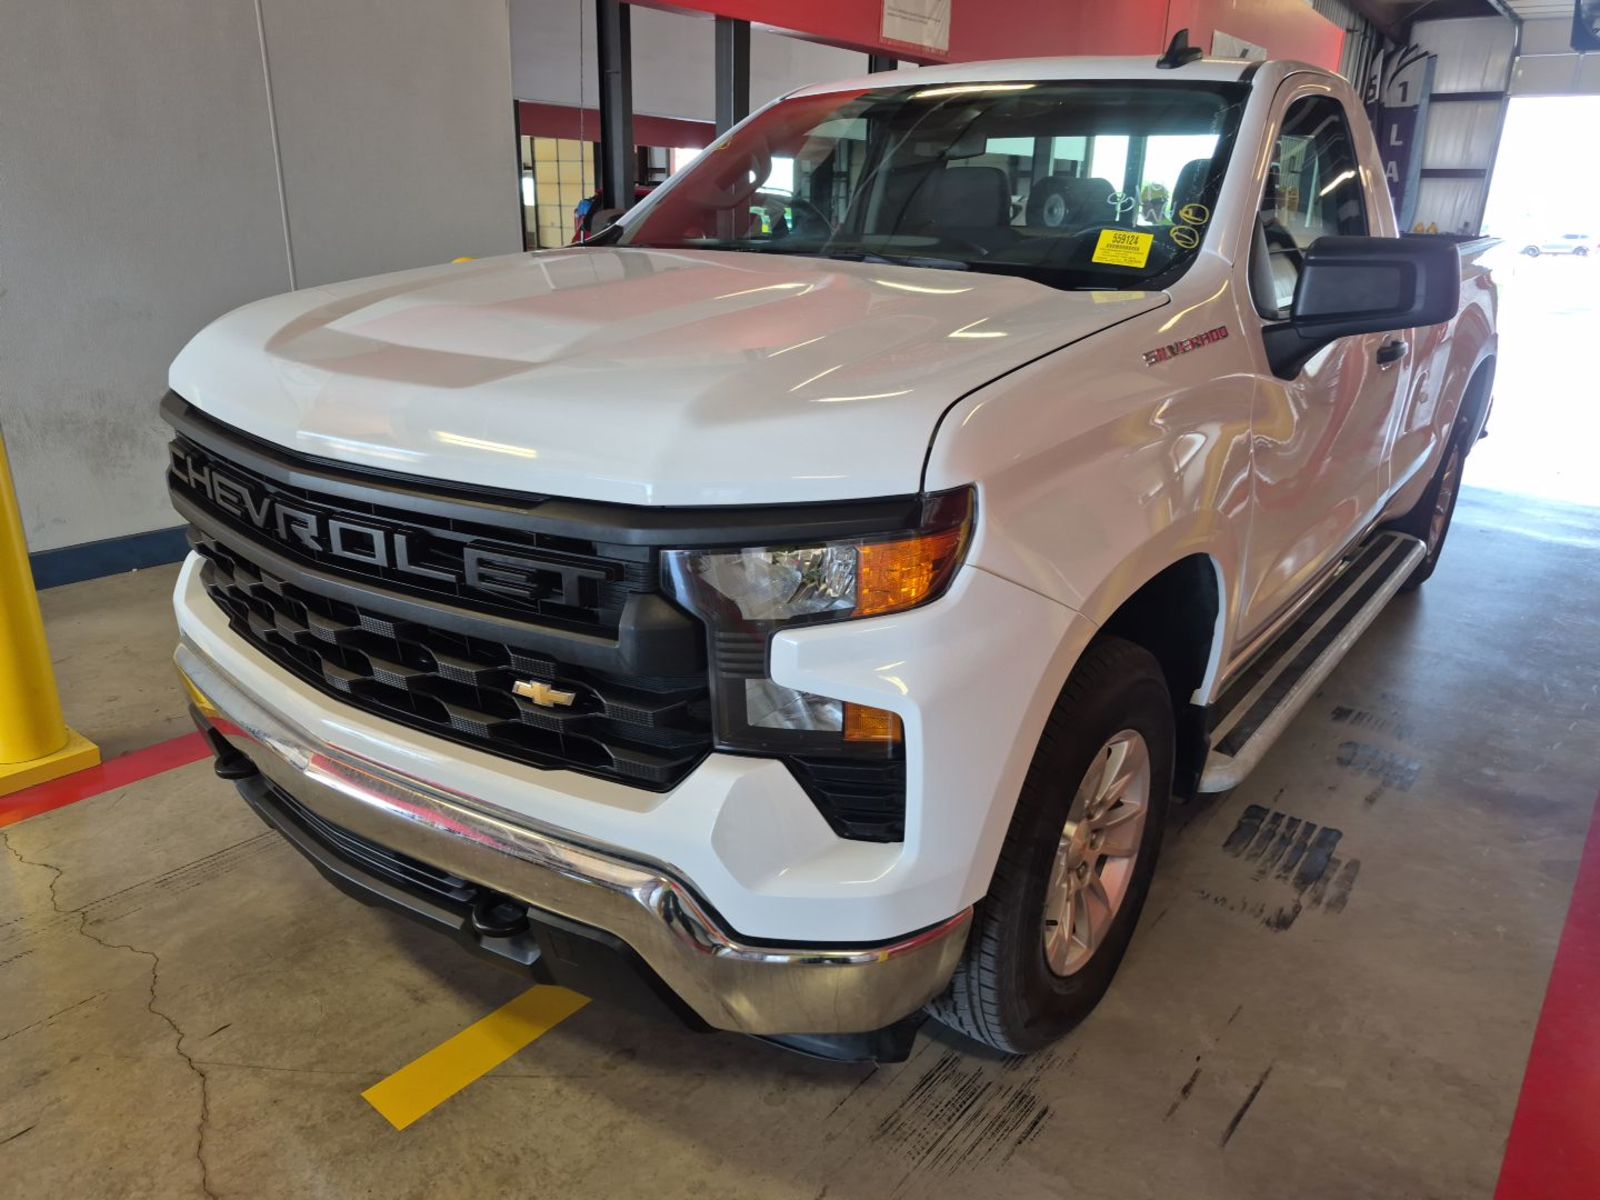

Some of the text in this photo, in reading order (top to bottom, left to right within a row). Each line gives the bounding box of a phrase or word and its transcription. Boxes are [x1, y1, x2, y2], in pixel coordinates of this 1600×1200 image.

[1112, 233, 1140, 245] 559124
[1142, 326, 1229, 368] SILVERADO
[169, 447, 610, 606] CHEVROLET
